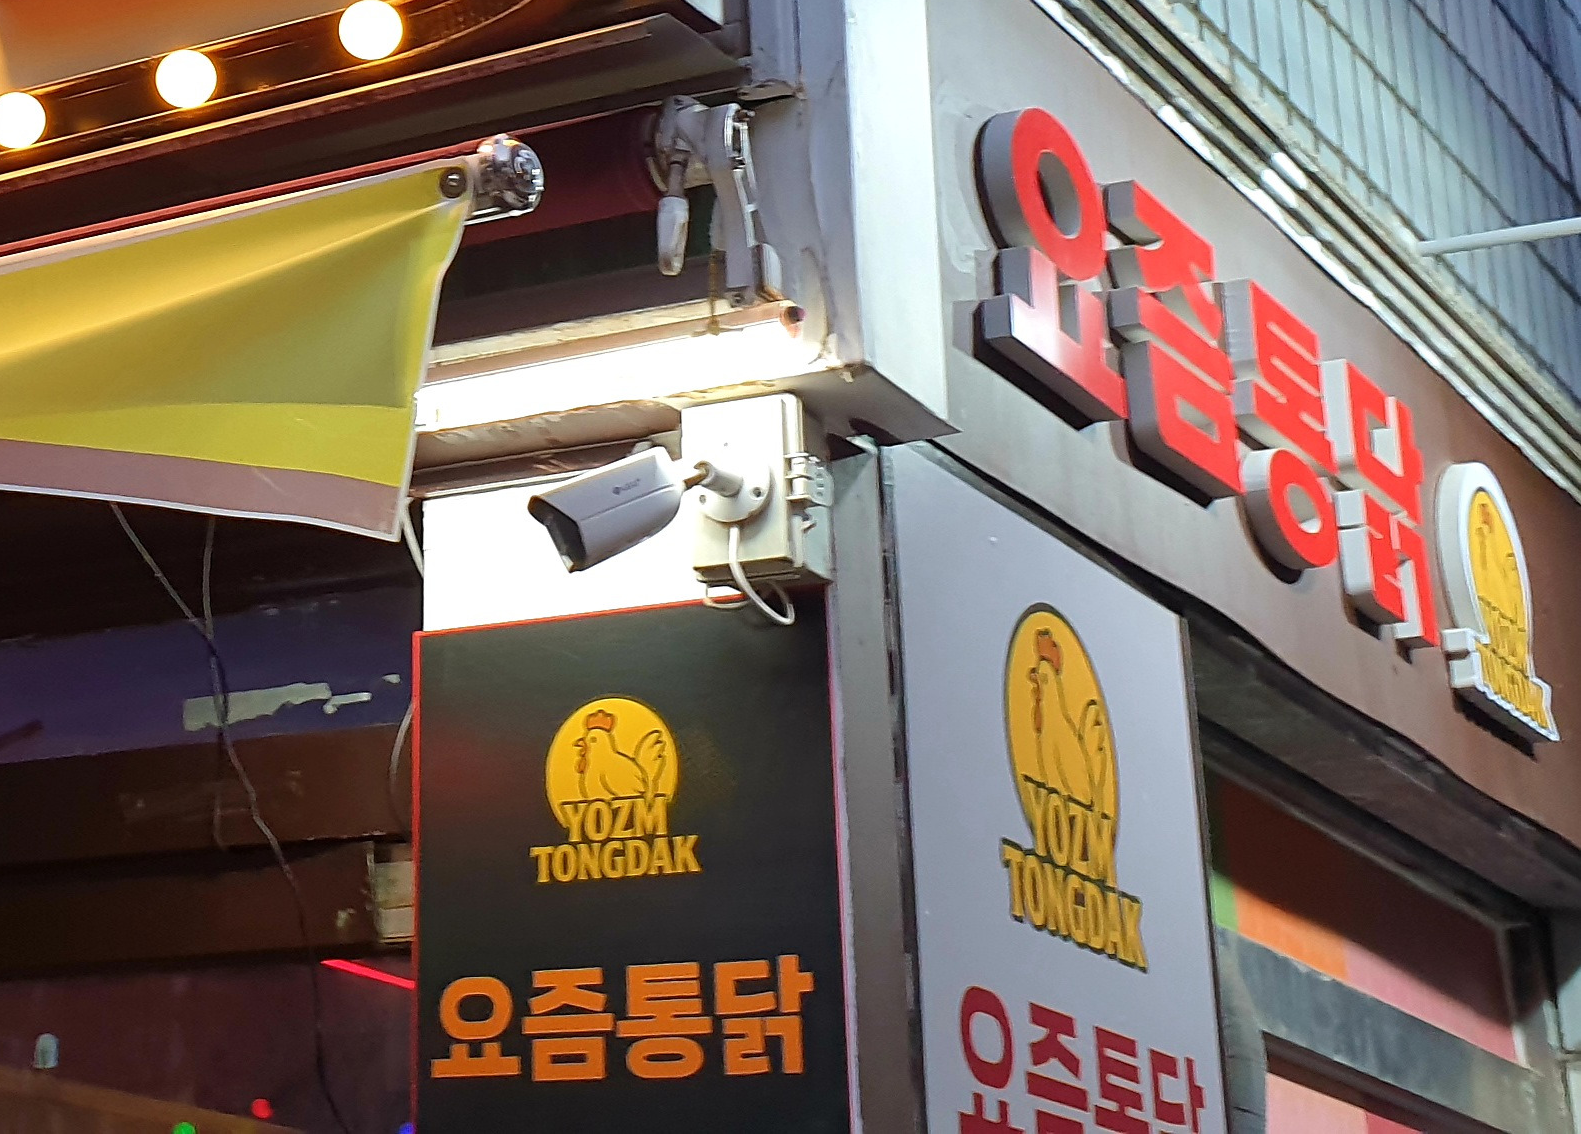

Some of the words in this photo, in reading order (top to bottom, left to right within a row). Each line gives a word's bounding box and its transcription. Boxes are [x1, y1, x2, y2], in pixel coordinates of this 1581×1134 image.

[1007, 107, 1440, 648] 요즘통닭
[530, 833, 702, 883] TONGDAK
[560, 795, 669, 843] YOZM
[1021, 778, 1119, 889] YOZM
[1000, 838, 1148, 972] TONGDAK
[430, 954, 815, 1082] 요즘통닭
